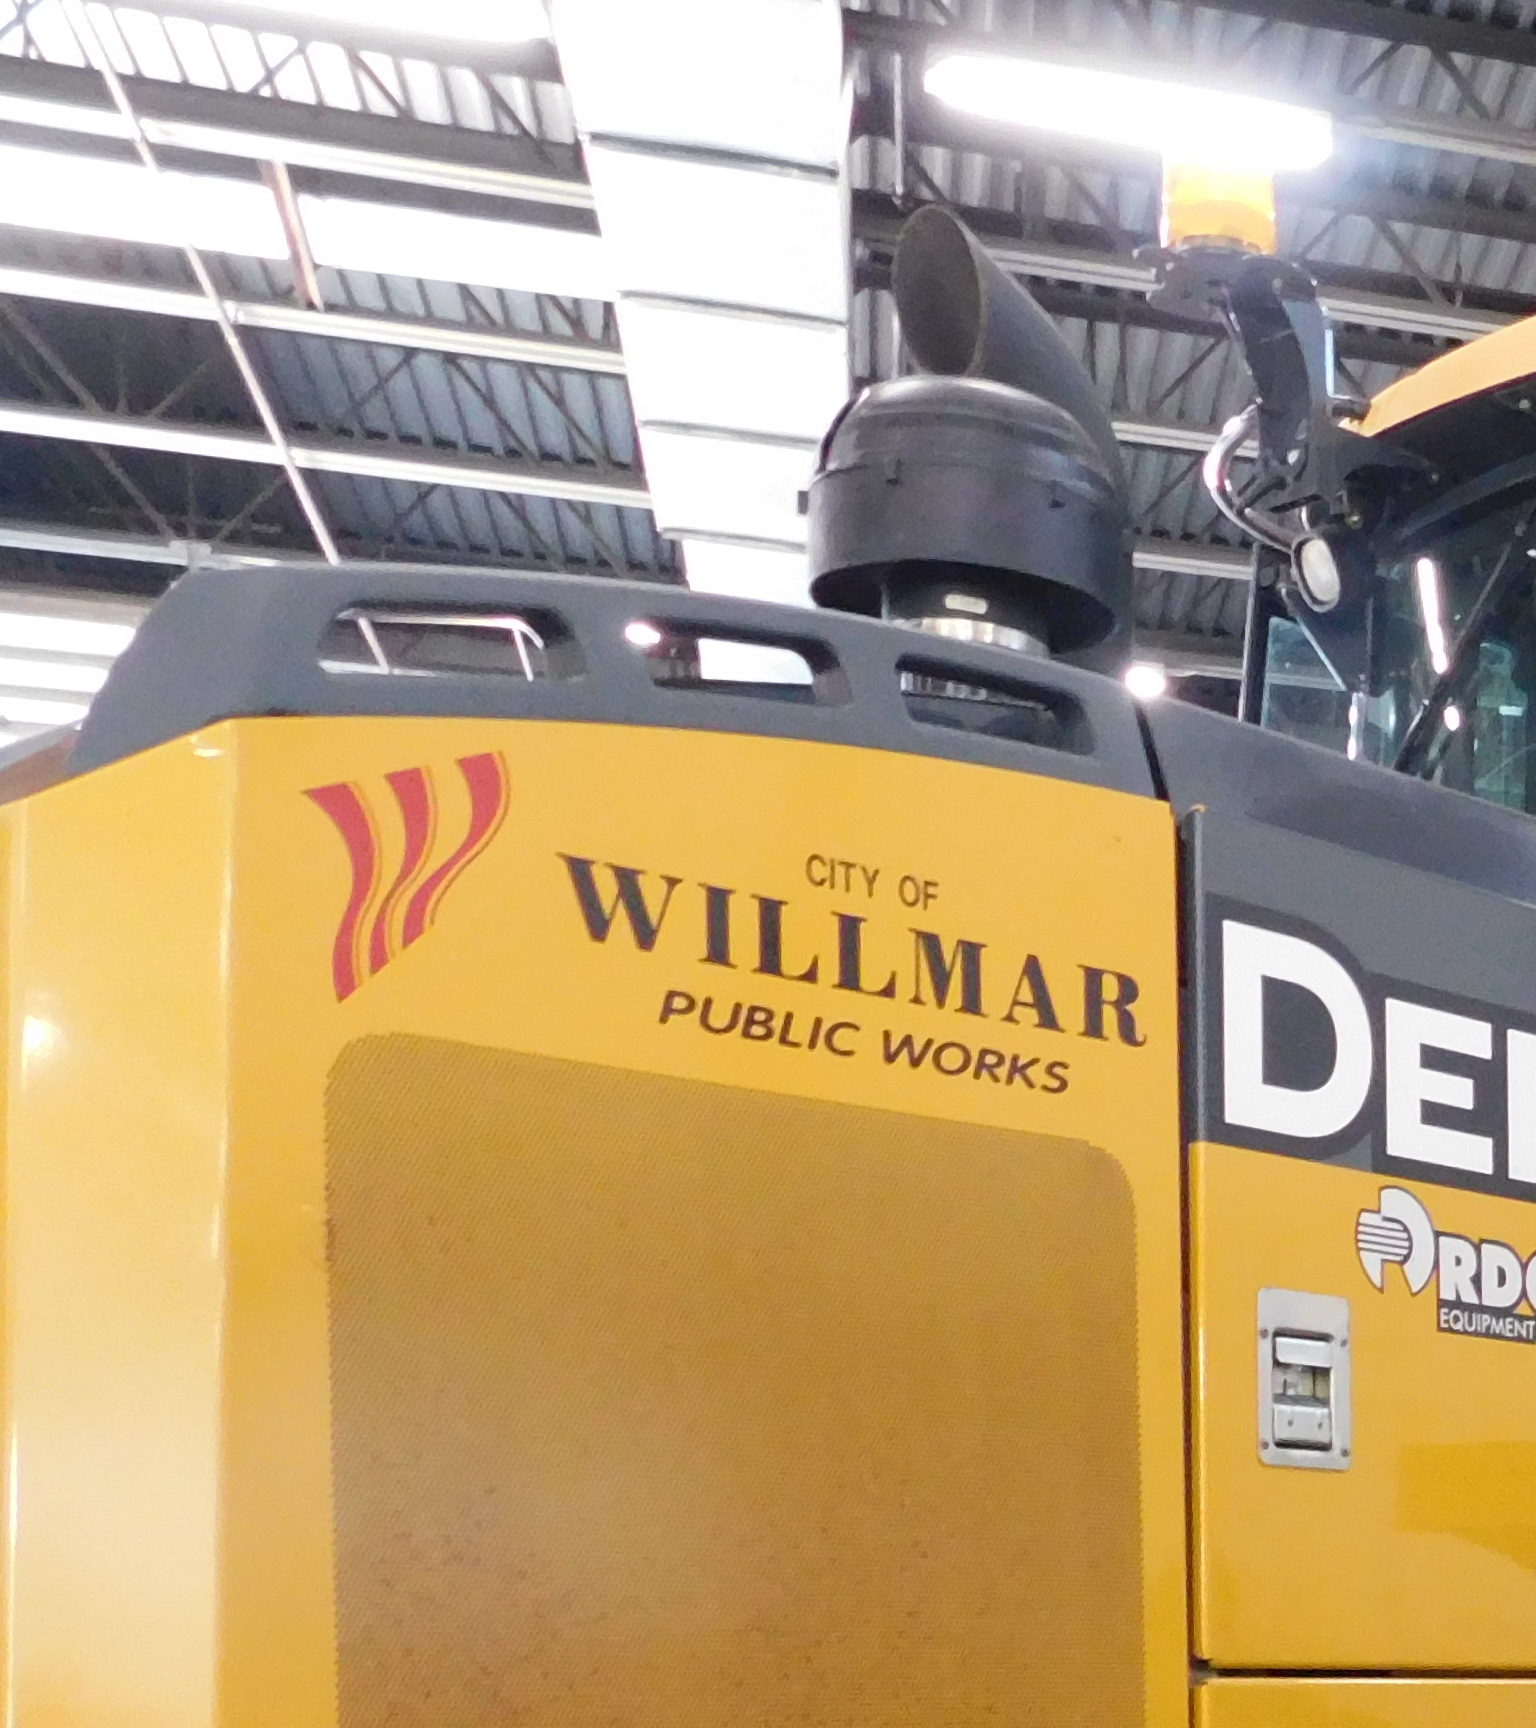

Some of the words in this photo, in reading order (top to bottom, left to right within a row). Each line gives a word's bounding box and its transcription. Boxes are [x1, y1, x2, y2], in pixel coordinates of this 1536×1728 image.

[806, 854, 880, 898] CITY
[899, 875, 939, 911] OF
[556, 851, 1148, 1048] WILLMAR
[658, 989, 861, 1058] PUBLIC
[881, 1030, 1070, 1095] WORKS
[1439, 1308, 1536, 1340] EQUIPMENT
